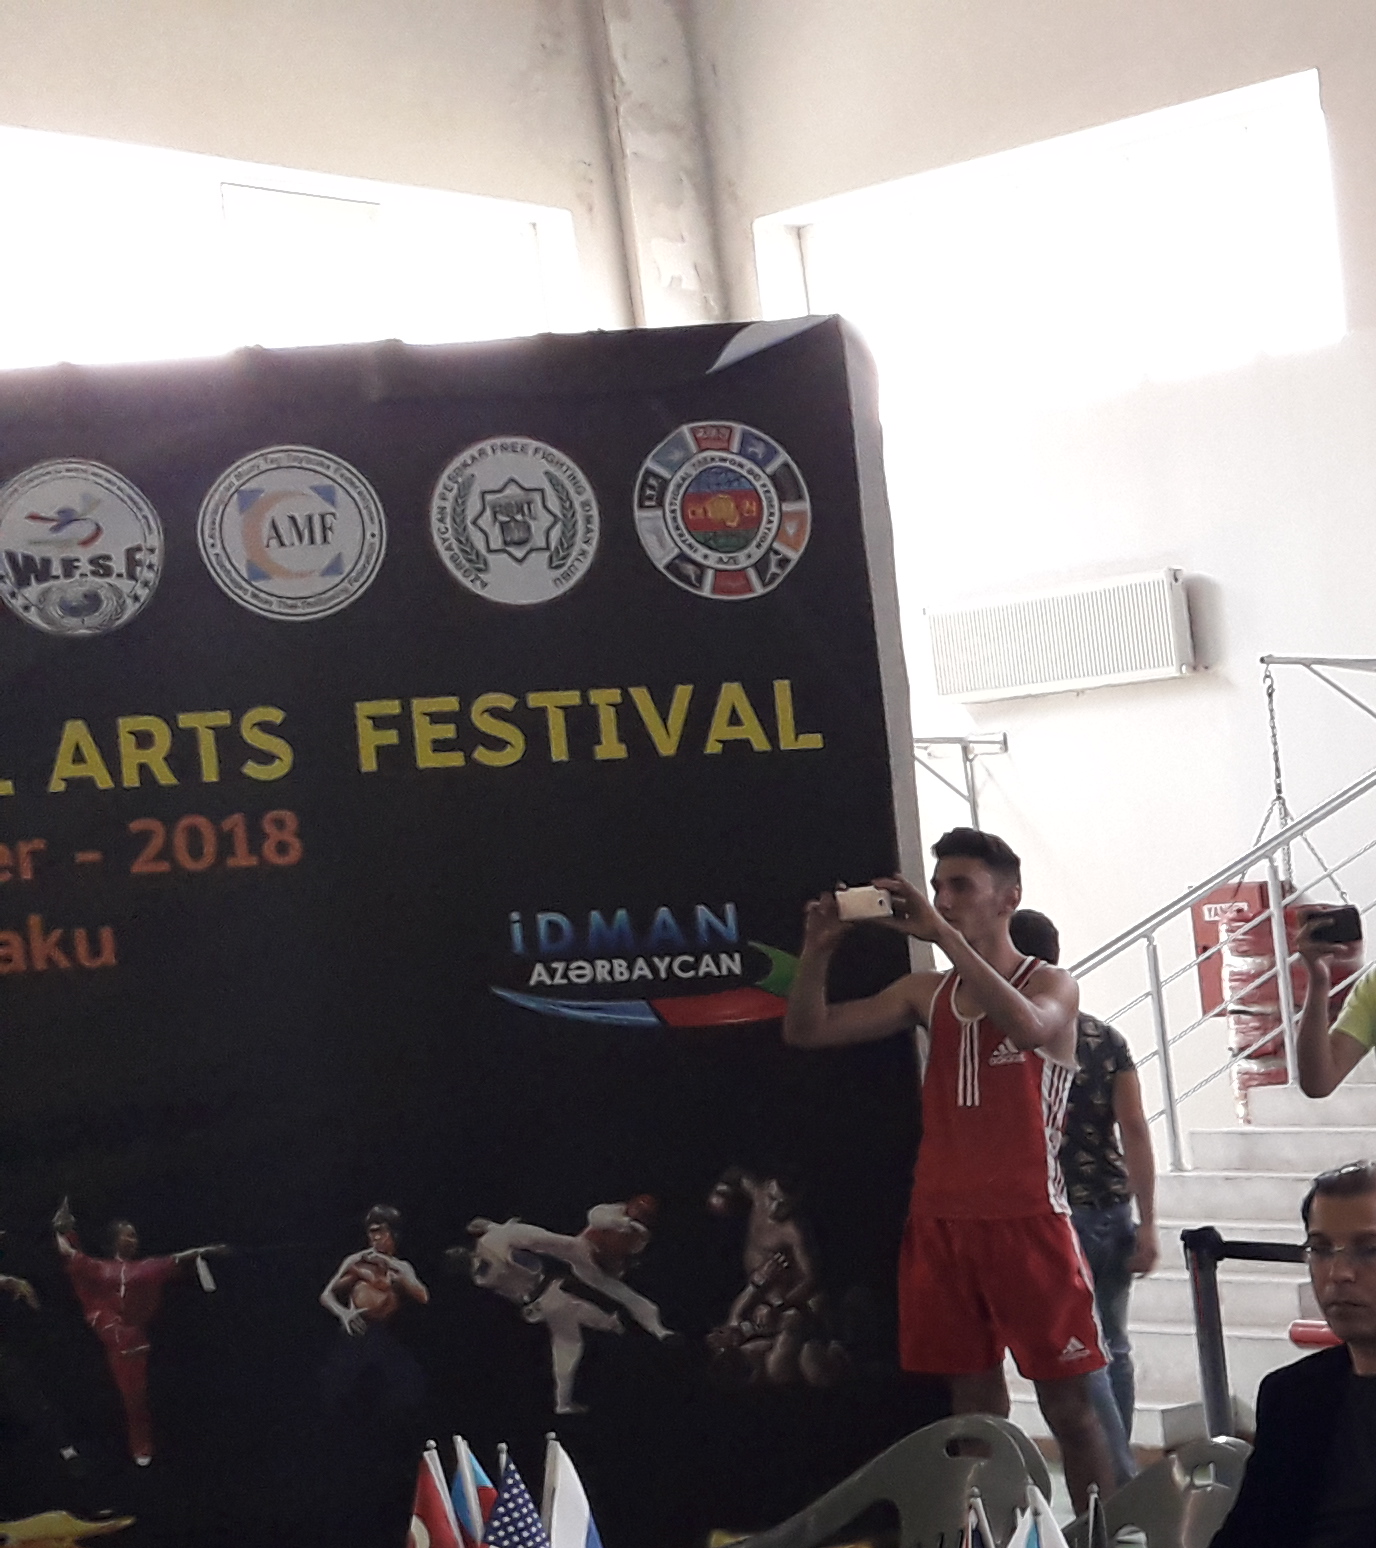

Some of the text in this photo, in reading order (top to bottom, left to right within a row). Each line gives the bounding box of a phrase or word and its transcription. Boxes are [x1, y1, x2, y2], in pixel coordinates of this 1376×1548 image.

[264, 511, 338, 549] AMF
[48, 680, 825, 793] ARTS FESTIVAL
[127, 810, 303, 874] 2018
